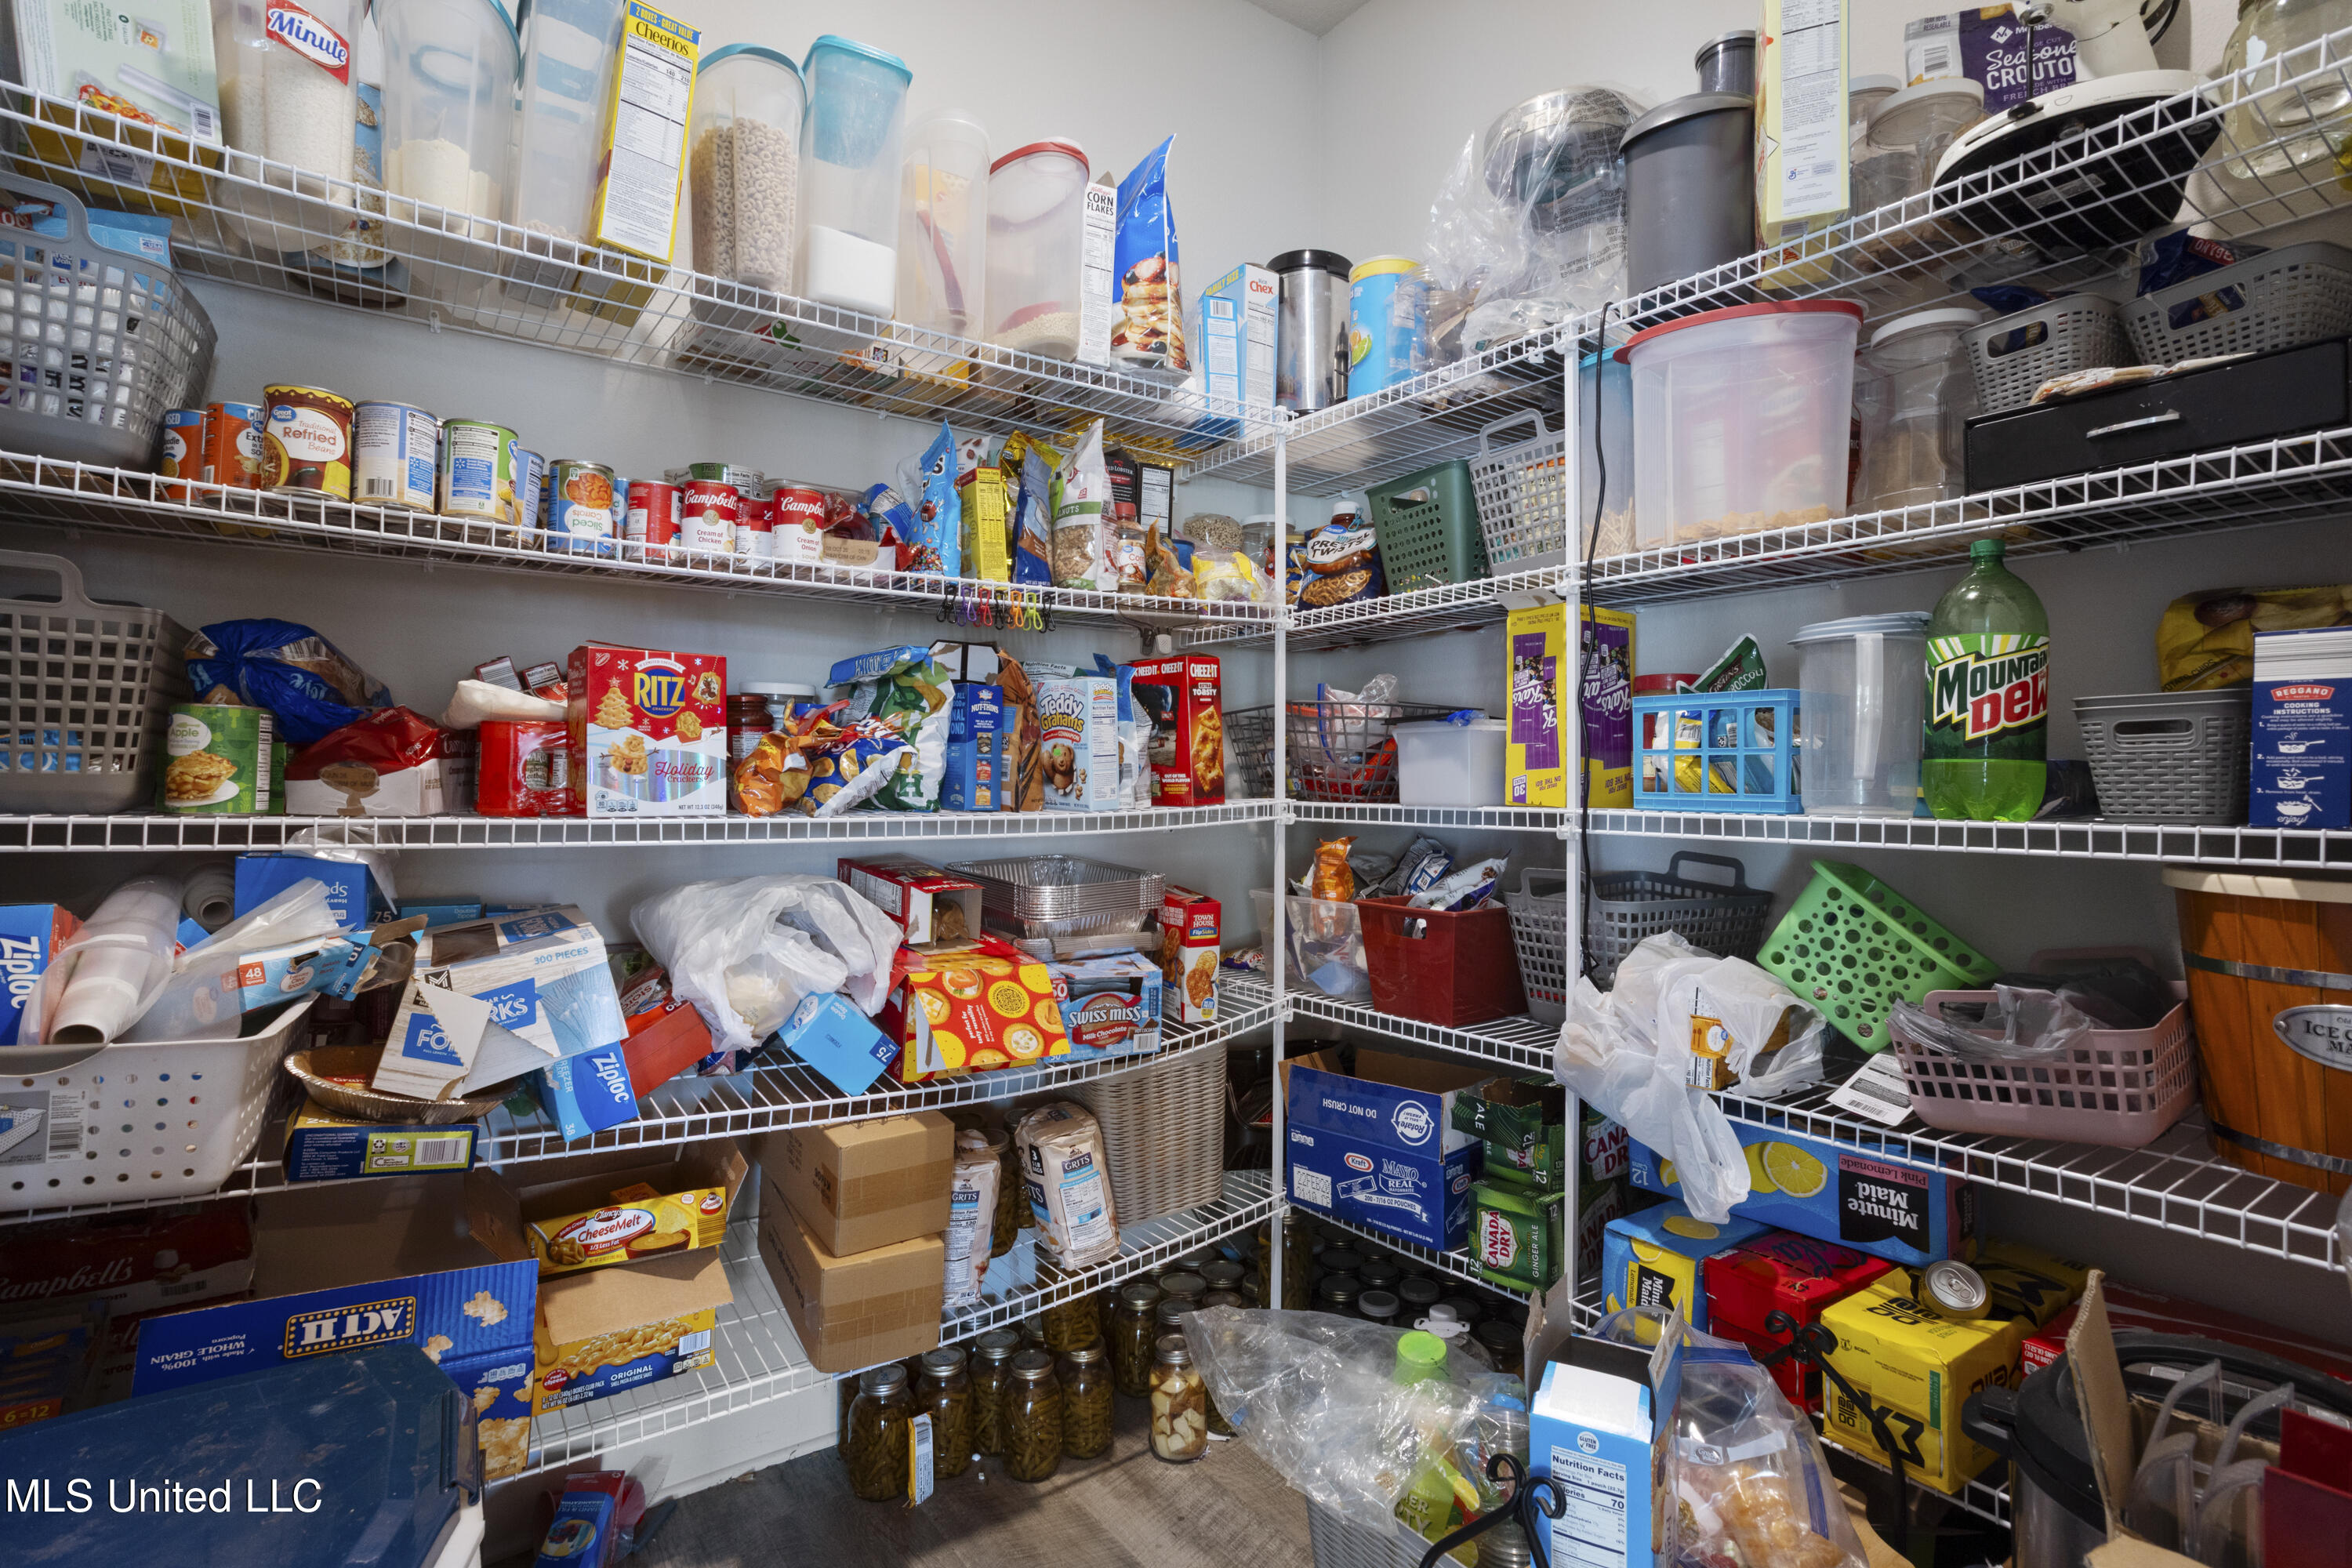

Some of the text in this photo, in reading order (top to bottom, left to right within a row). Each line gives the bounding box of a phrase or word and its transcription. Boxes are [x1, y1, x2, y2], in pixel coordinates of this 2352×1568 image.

[641, 7, 694, 41] BOXES GREAT VALUE
[1923, 20, 1951, 31] RESEALABLE
[268, 9, 348, 64] Minute
[636, 20, 688, 56] Cheerios
[1087, 191, 1114, 208] CORN
[1087, 202, 1114, 216] FLAKES
[1205, 269, 1240, 296] FAMILY SIZE
[1250, 279, 1274, 296] Chex
[283, 426, 337, 446] Refried
[299, 420, 337, 436] Traditional
[307, 441, 336, 456] Beans
[1114, 465, 1134, 474] LOBSTER
[685, 489, 737, 510] Campbell's
[572, 510, 602, 521] Carrots
[572, 519, 603, 532] Sliced
[697, 529, 717, 538] Cream
[698, 536, 722, 545] Chicken
[797, 537, 812, 546] Cream
[526, 668, 543, 678] Nutrition
[634, 673, 685, 708] RITZ
[1093, 682, 1113, 691] Teddy
[2276, 687, 2328, 697] REGGANO
[1040, 693, 1084, 717] Teddy
[1040, 712, 1085, 733] Grahams
[170, 726, 199, 739] Apple
[1058, 731, 1080, 741] CINNAMON
[655, 761, 714, 780] Holiday
[667, 775, 703, 783] Crackers
[1544, 776, 1553, 785] THE
[1514, 784, 1526, 797] 30
[2277, 815, 2309, 826] enjoy!
[375, 911, 393, 923] 75
[1193, 913, 1214, 922] TOWN
[348, 946, 363, 962] 10
[534, 947, 590, 965] 300 PIECES
[245, 967, 262, 978] 48
[666, 1000, 682, 1012] 50
[1068, 1004, 1142, 1028] SWISS MISS
[1082, 1025, 1127, 1041] Milk Chocolate
[2302, 1019, 2340, 1039] ICE
[875, 1047, 892, 1063] 75
[591, 1051, 630, 1103] Ziploc
[1323, 1098, 1377, 1119] DO NOT CRUSH
[1475, 1102, 1485, 1131] ALE
[565, 1123, 575, 1136] 38
[1399, 1120, 1425, 1134] Rotate
[1523, 1131, 1534, 1151] 12
[1031, 1151, 1037, 1160] 3
[1065, 1155, 1091, 1171] GRITS
[1350, 1157, 1367, 1167] Kraft
[1382, 1158, 1419, 1180] MAYO
[1632, 1160, 1649, 1186] 12 Cans
[1839, 1158, 1926, 1187] Pink Lemonade
[1388, 1179, 1414, 1188] REAL
[1454, 1178, 1468, 1189] Kraft
[1535, 1170, 1548, 1185] 12
[952, 1192, 977, 1201] GRITS
[1857, 1182, 1909, 1210] Maid
[1394, 1200, 1417, 1210] POUCHES
[1548, 1204, 1557, 1218] 12
[593, 1207, 623, 1222] Clancy's
[1847, 1197, 1919, 1231] Minute
[559, 1218, 587, 1238] Melts Great!
[577, 1214, 641, 1243] CheeseMelt
[1486, 1210, 1500, 1269] CANADA
[1499, 1226, 1510, 1259] DRY
[1470, 1258, 1479, 1273] 12
[1640, 1276, 1653, 1306] Maid
[299, 1307, 404, 1346] ACT II
[212, 1334, 246, 1344] Popcorn
[150, 1340, 245, 1366] WHOLE GRAIN
[161, 1348, 245, 1372] Made with 100%
[543, 1375, 568, 1386] cheese
[610, 1364, 653, 1381] ORIGINAL
[633, 1374, 643, 1384] CHEESE
[643, 1371, 652, 1380] SAUCE
[558, 1380, 605, 1399] (340g) BOXES CLUB PACK
[28, 1404, 50, 1420] 12
[1579, 1436, 1598, 1444] GLUTEN
[1585, 1442, 1597, 1450] FREE
[1552, 1454, 1595, 1473] Nutrition
[1597, 1468, 1625, 1482] Facts
[1552, 1469, 1571, 1479] Serving
[1591, 1481, 1606, 1490] pouch
[1610, 1498, 1624, 1510] 70
